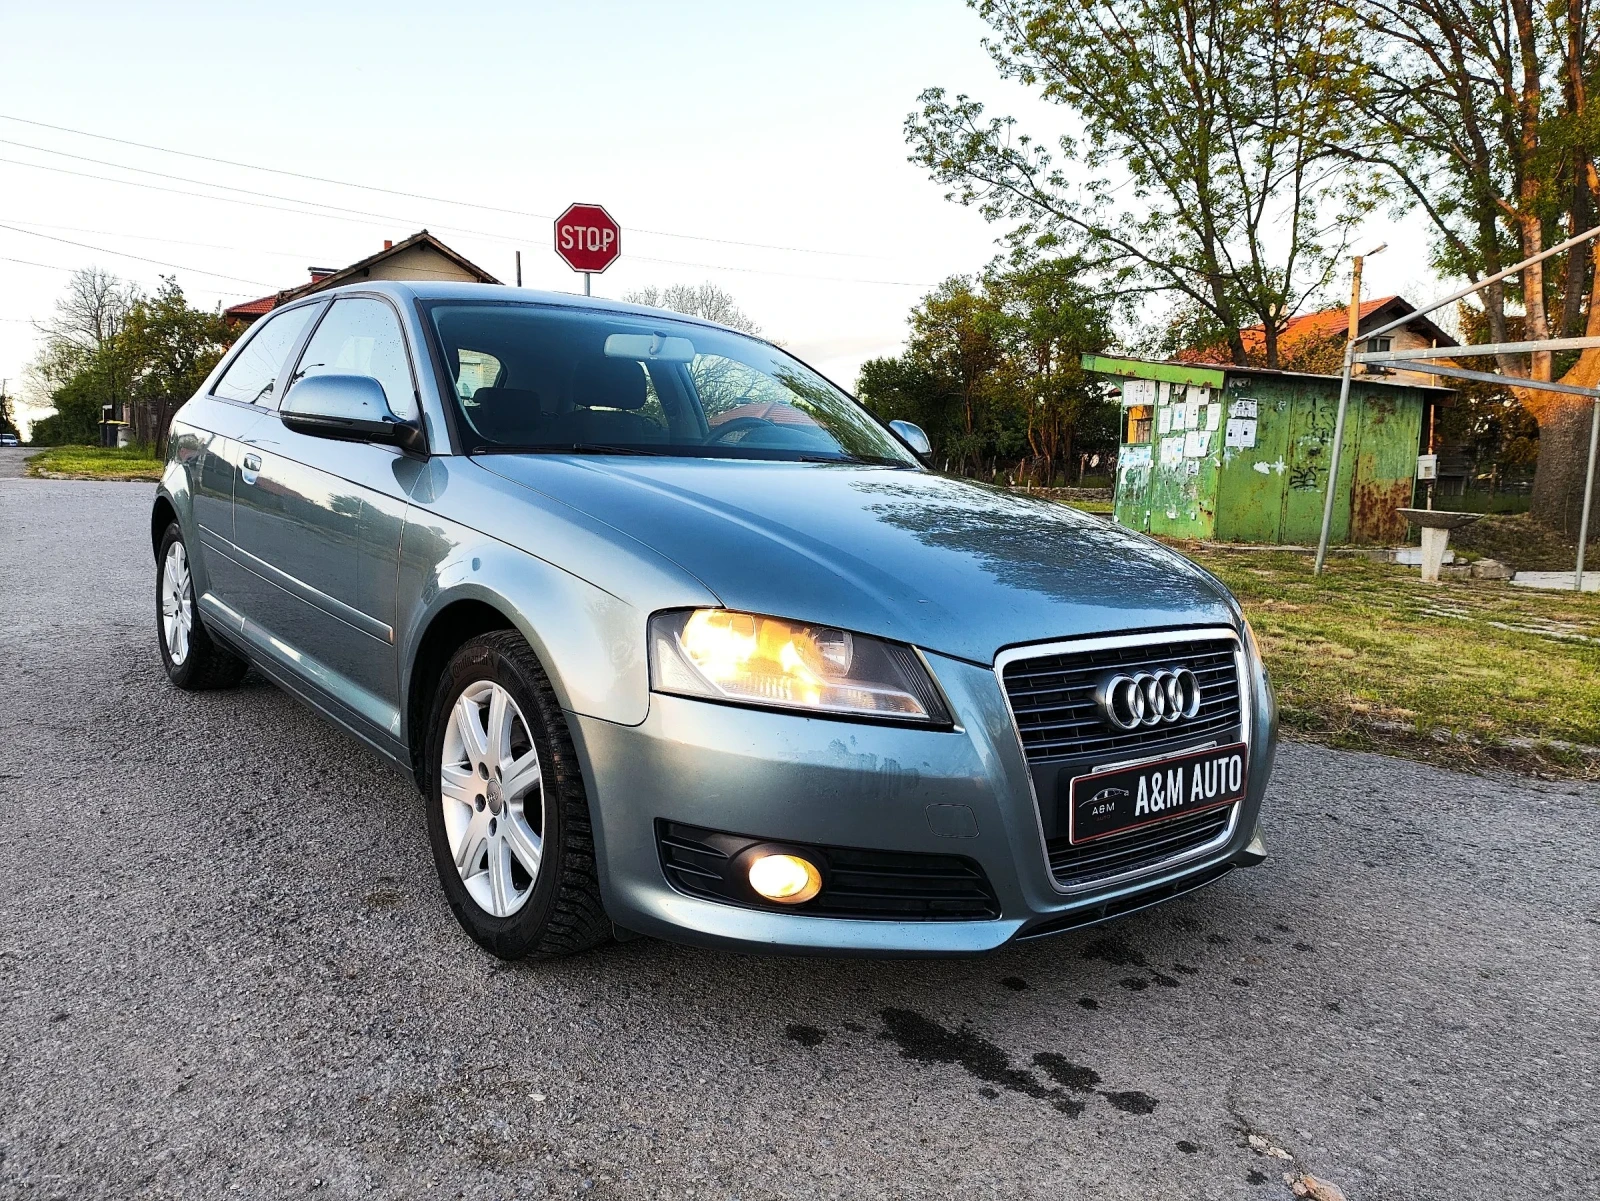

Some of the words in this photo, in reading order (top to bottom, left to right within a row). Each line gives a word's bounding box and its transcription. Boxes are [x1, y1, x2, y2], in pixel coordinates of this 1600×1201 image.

[561, 225, 615, 252] STOP
[1134, 767, 1184, 817] A&M
[1190, 754, 1242, 802] AUTO
[1091, 801, 1115, 816] A&M
